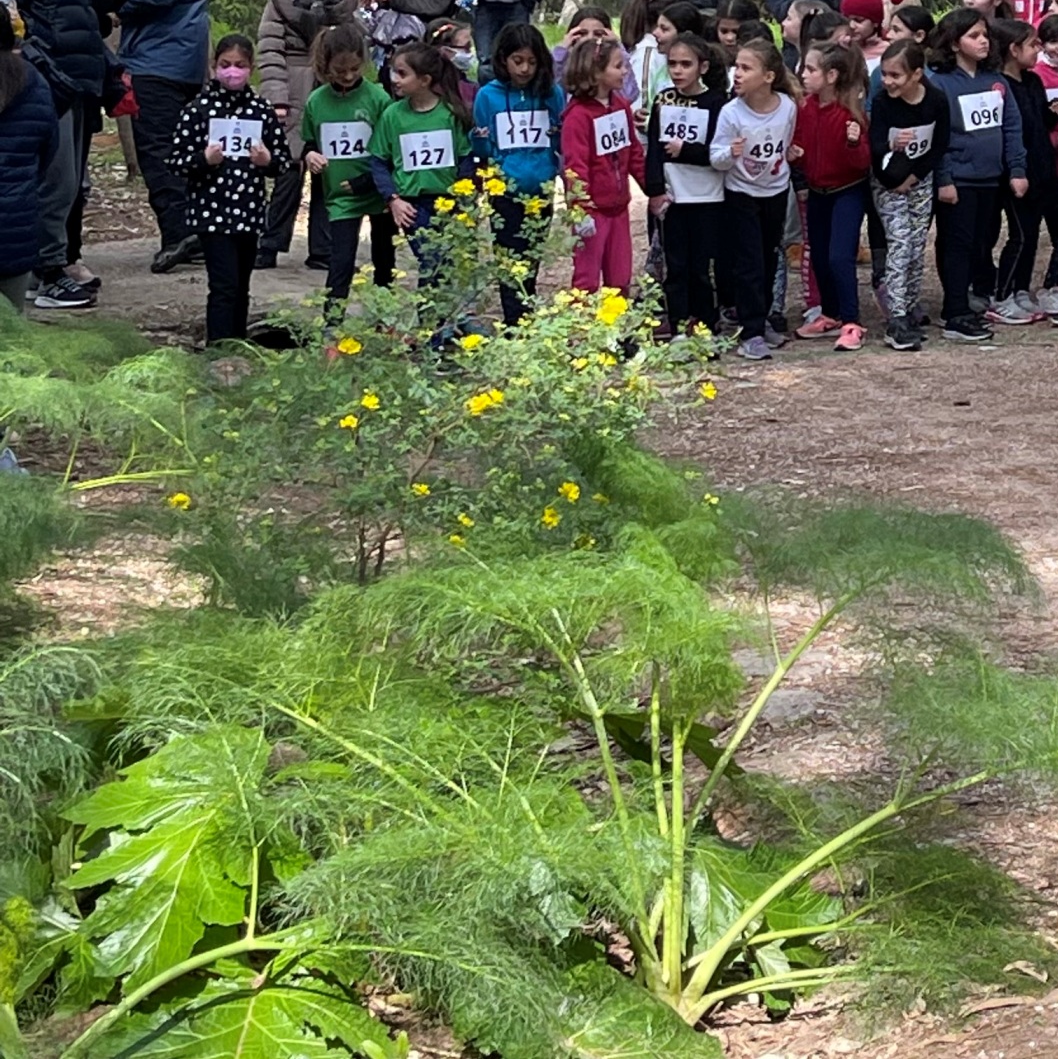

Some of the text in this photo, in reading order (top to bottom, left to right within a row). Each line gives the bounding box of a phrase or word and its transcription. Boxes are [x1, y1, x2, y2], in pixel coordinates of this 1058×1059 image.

[970, 106, 999, 126] 096
[506, 127, 542, 145] 117
[664, 122, 698, 142] 485
[218, 135, 252, 153] 134
[328, 138, 365, 156] 124
[749, 139, 784, 159] 494
[908, 139, 929, 157] 99
[409, 148, 445, 167] 127
